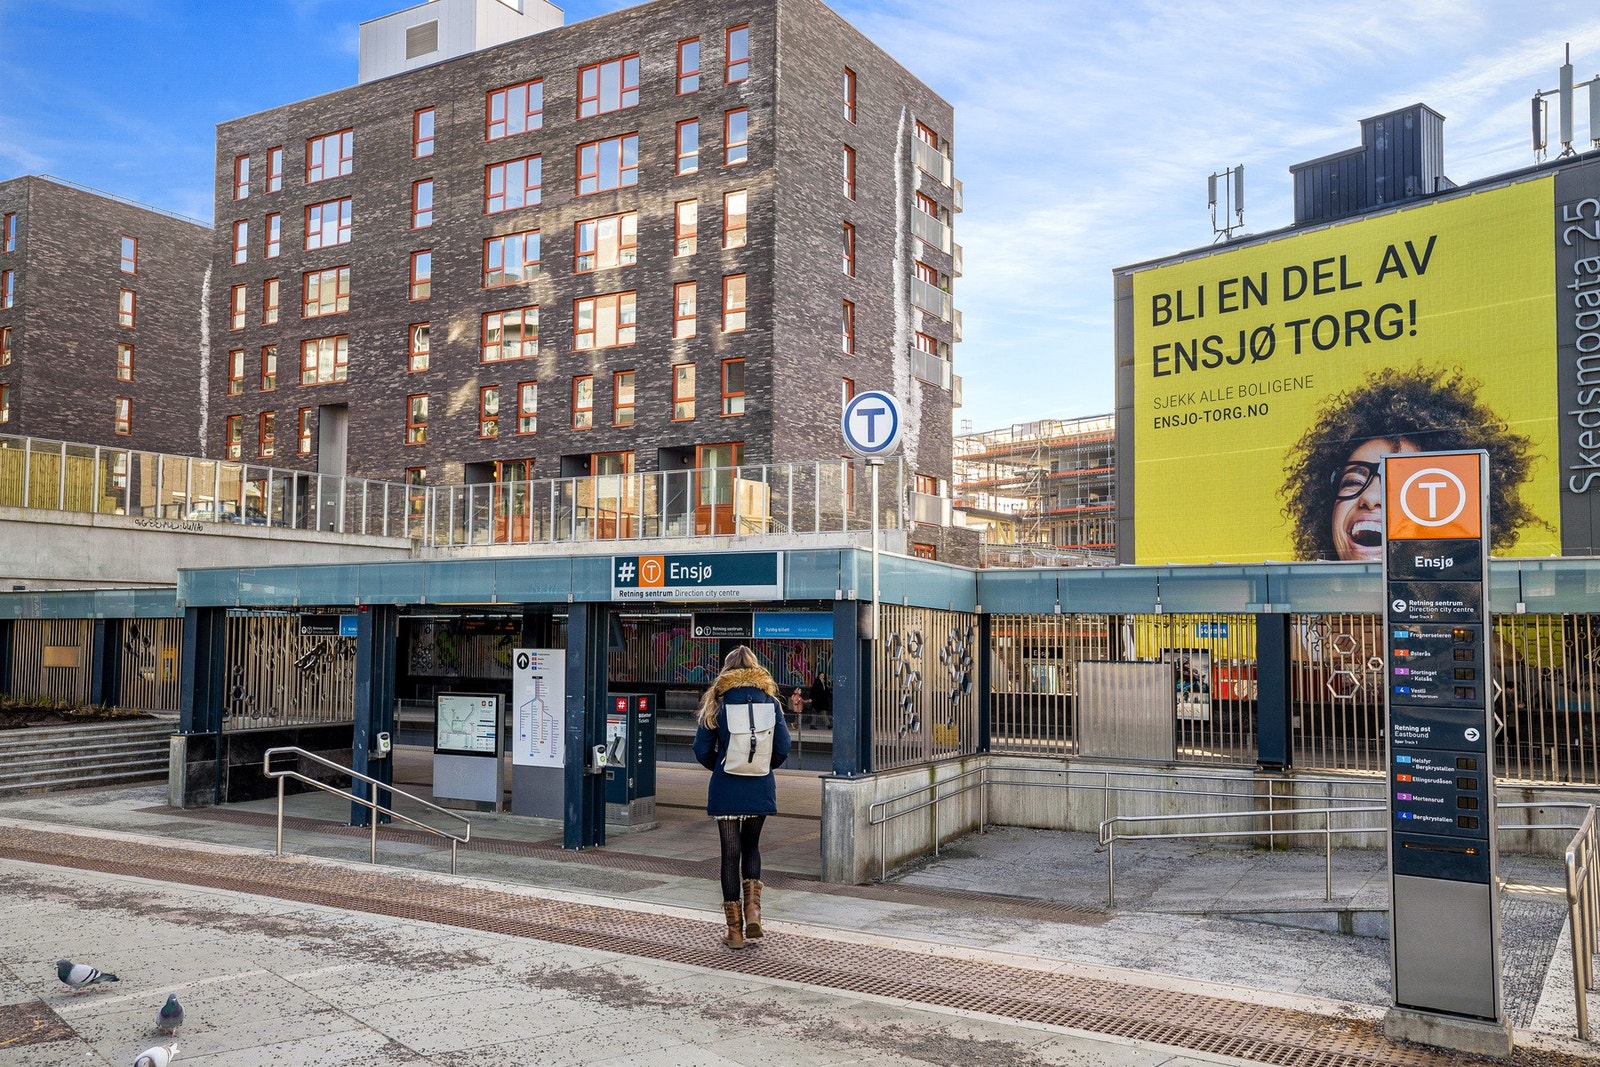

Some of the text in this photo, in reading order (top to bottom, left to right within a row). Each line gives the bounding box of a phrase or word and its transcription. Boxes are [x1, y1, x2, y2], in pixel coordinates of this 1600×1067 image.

[1152, 235, 1438, 327] BLI EN DEL AV
[1152, 299, 1417, 378] ENSJØ TORG!
[1563, 198, 1600, 494] Skedsmogata 25
[1153, 375, 1314, 410] SJEKK ALLE BOLIGENE
[857, 408, 885, 443] T
[1153, 402, 1269, 429] ENSJO-TORG.NO
[1418, 482, 1447, 518] T
[670, 562, 712, 583] Ensjø
[1415, 556, 1454, 570] Ensjø
[619, 590, 644, 598] Retning
[675, 589, 703, 597] Direction
[705, 589, 717, 598] city
[719, 589, 740, 597] centre
[1394, 724, 1419, 732] Retning
[1415, 764, 1455, 772] Bergkrystallen
[1412, 776, 1452, 784] Ellingsrudåsen
[1413, 795, 1444, 803] Mortensrud
[1413, 814, 1453, 823] Bergkrystallen
